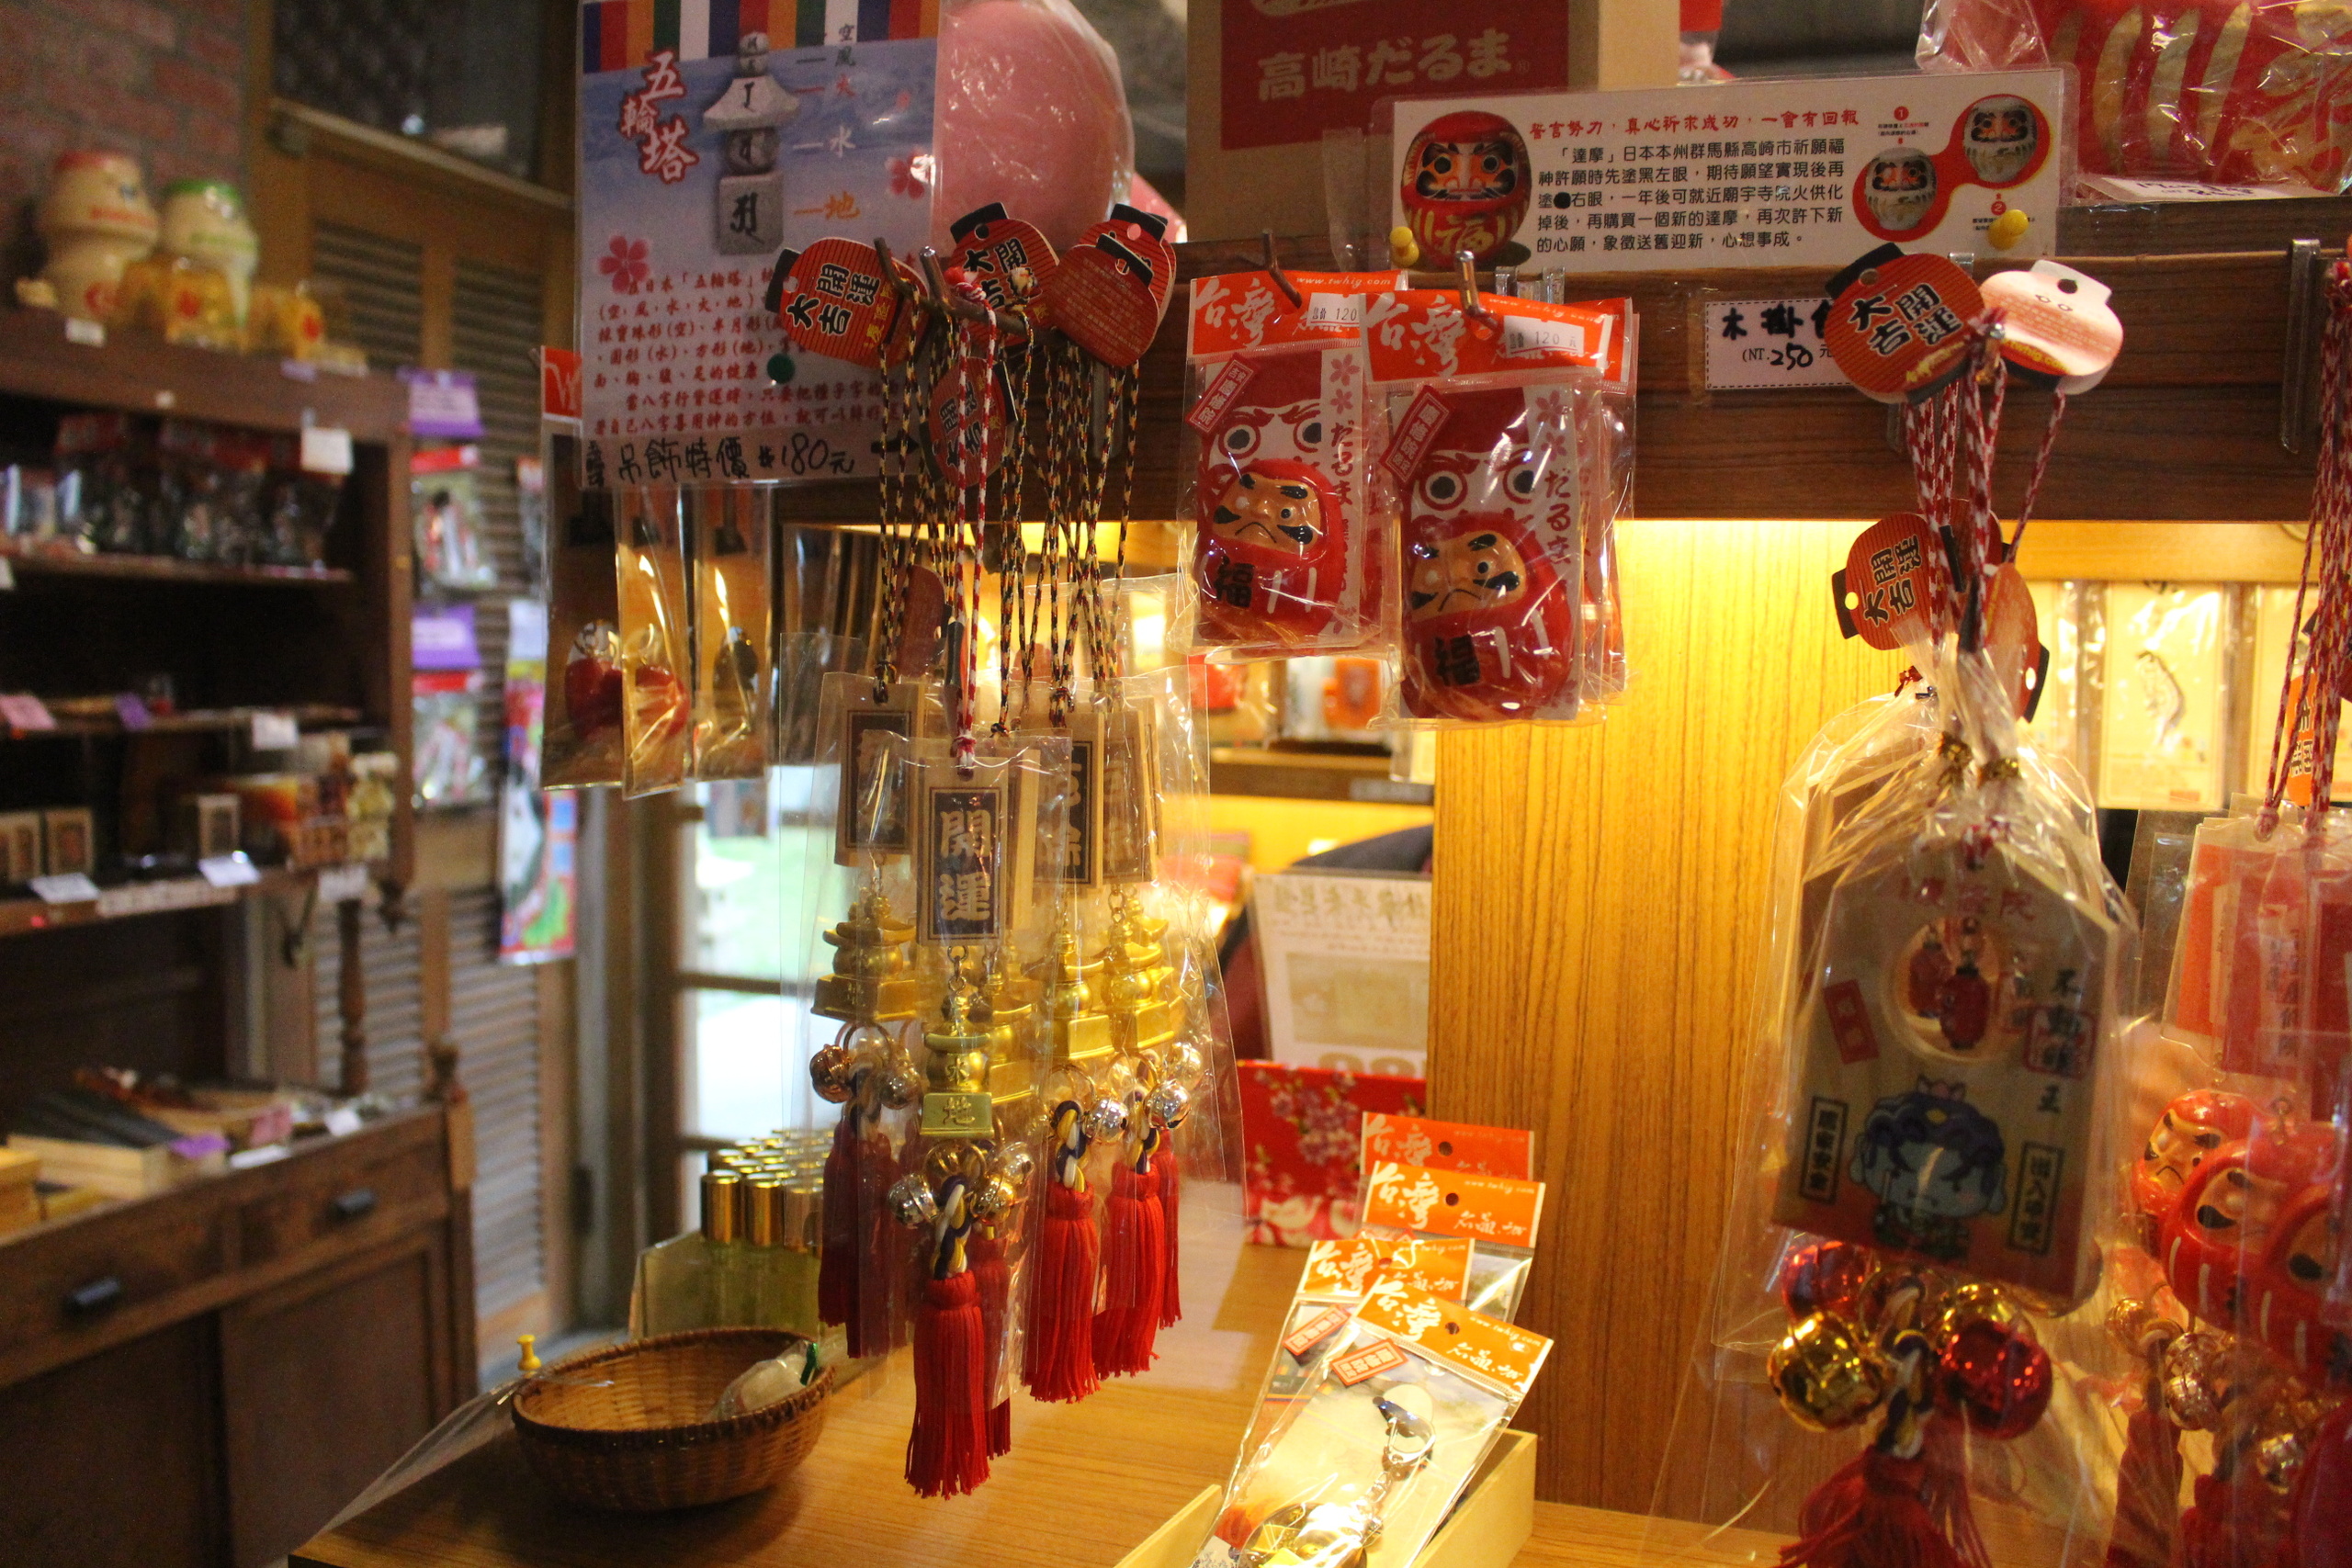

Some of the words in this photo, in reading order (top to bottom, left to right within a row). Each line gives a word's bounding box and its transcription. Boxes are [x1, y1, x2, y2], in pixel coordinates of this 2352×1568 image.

[1257, 28, 1511, 102] 高崎だるま
[621, 51, 698, 183] 五輪塔
[830, 125, 855, 158] 水
[1561, 138, 1845, 165] 「達摩」日本本州群馬縣高崎市祈願福
[824, 191, 861, 220] 地
[1538, 184, 1844, 209] 塗右眼，一年後可就近廟宇寺院火供化
[786, 293, 854, 337] 大吉
[1195, 277, 1275, 349] 台灣
[1336, 308, 1358, 321] 120
[1362, 292, 1467, 377] 台灣
[1534, 331, 1560, 345] 120
[1848, 293, 1912, 359] 大吉
[1898, 282, 1965, 346] 開運
[618, 437, 750, 479] 吊飾特價
[1544, 468, 1572, 566] だるま
[939, 809, 992, 921] 開運
[1363, 1112, 1432, 1168] 台灣
[1371, 1163, 1440, 1229] 台灣
[1310, 1241, 1374, 1296] 台灣
[1372, 1276, 1441, 1342] 台灣
